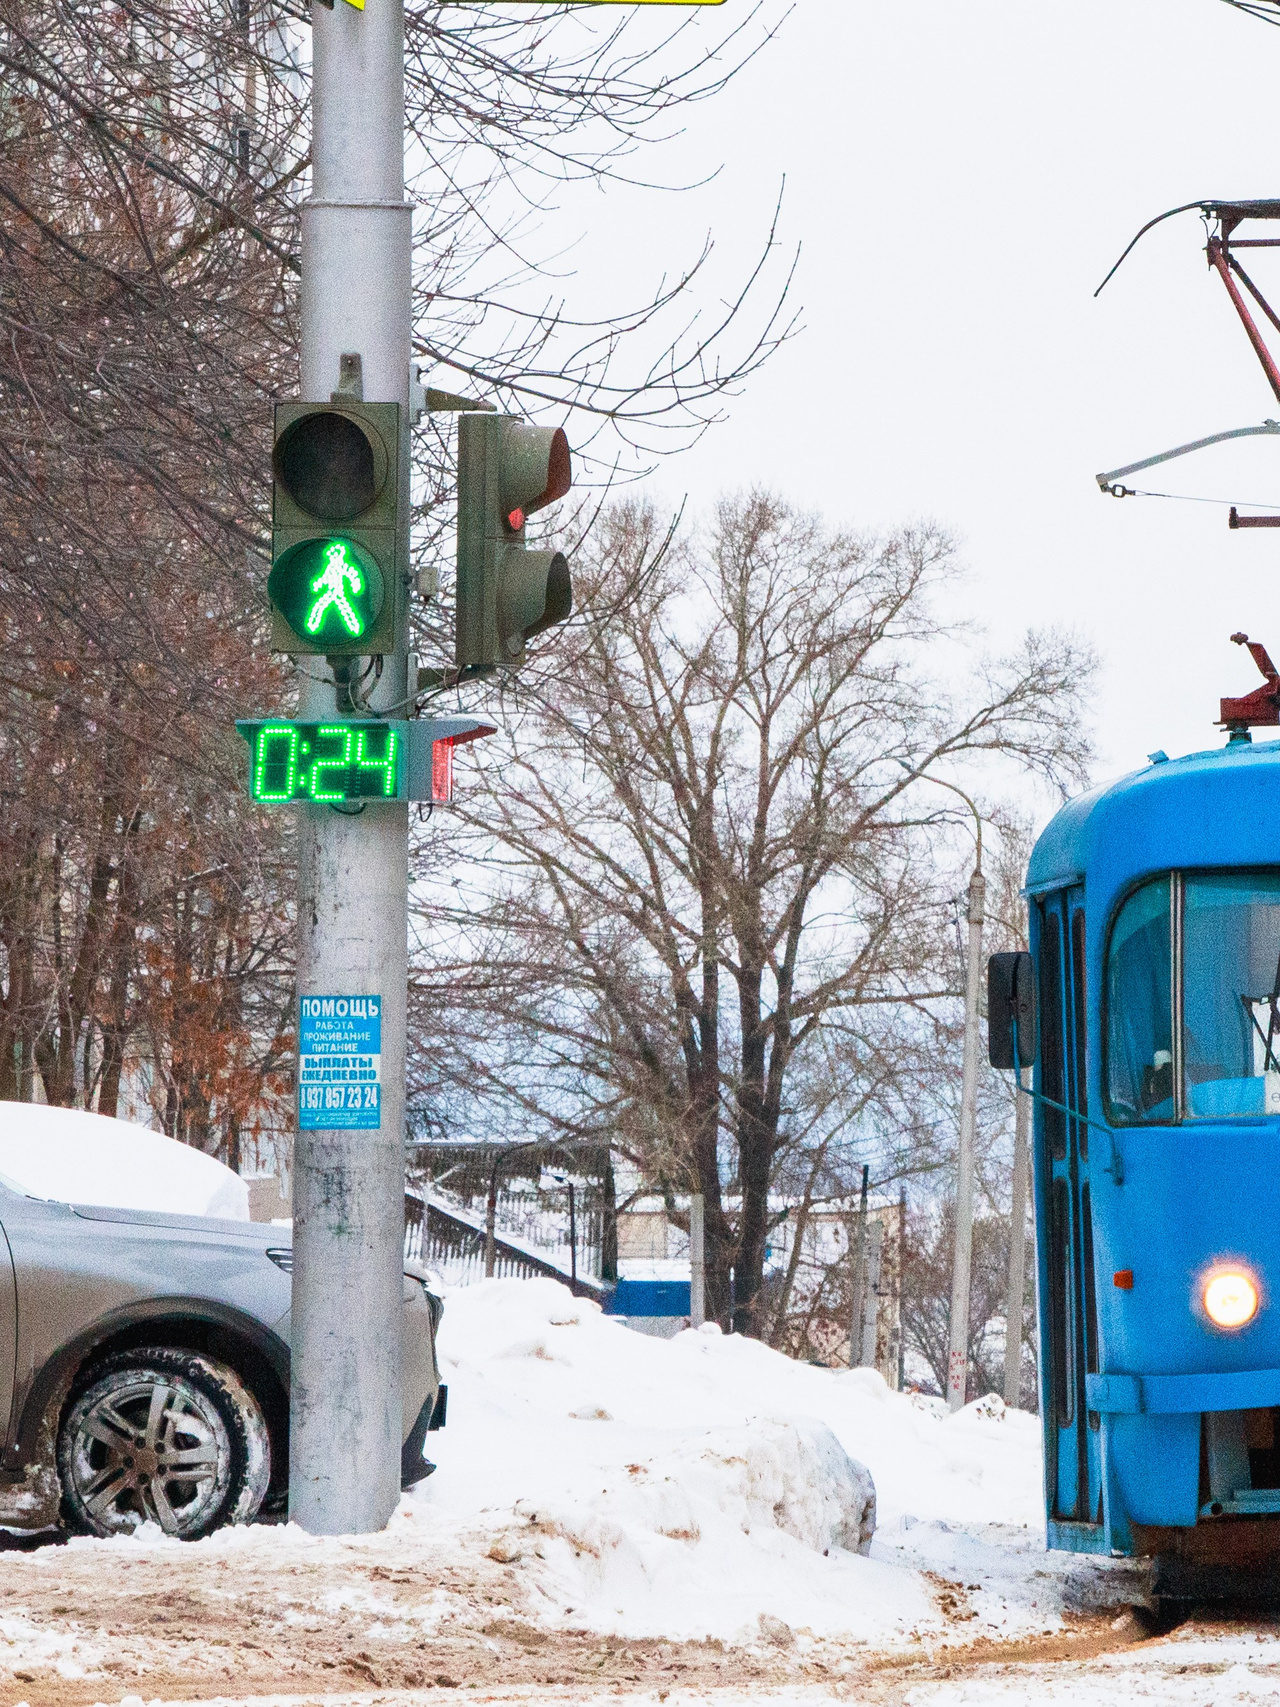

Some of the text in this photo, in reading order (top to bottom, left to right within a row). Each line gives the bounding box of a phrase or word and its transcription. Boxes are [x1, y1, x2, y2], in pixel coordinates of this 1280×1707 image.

[254, 725, 398, 803] 0:24
[302, 999, 379, 1019] ПОМОЩЬ
[315, 1021, 354, 1030] РАБОТА
[304, 1032, 371, 1041] ПРОЖИВАНИЕ
[312, 1043, 359, 1052] ПИТАНИЕ
[304, 1057, 373, 1069] ВЫПЛАТЫ
[302, 1070, 377, 1082] ЕЖЕДНЕВНО
[300, 1086, 379, 1109] 8 937 857 23 24
